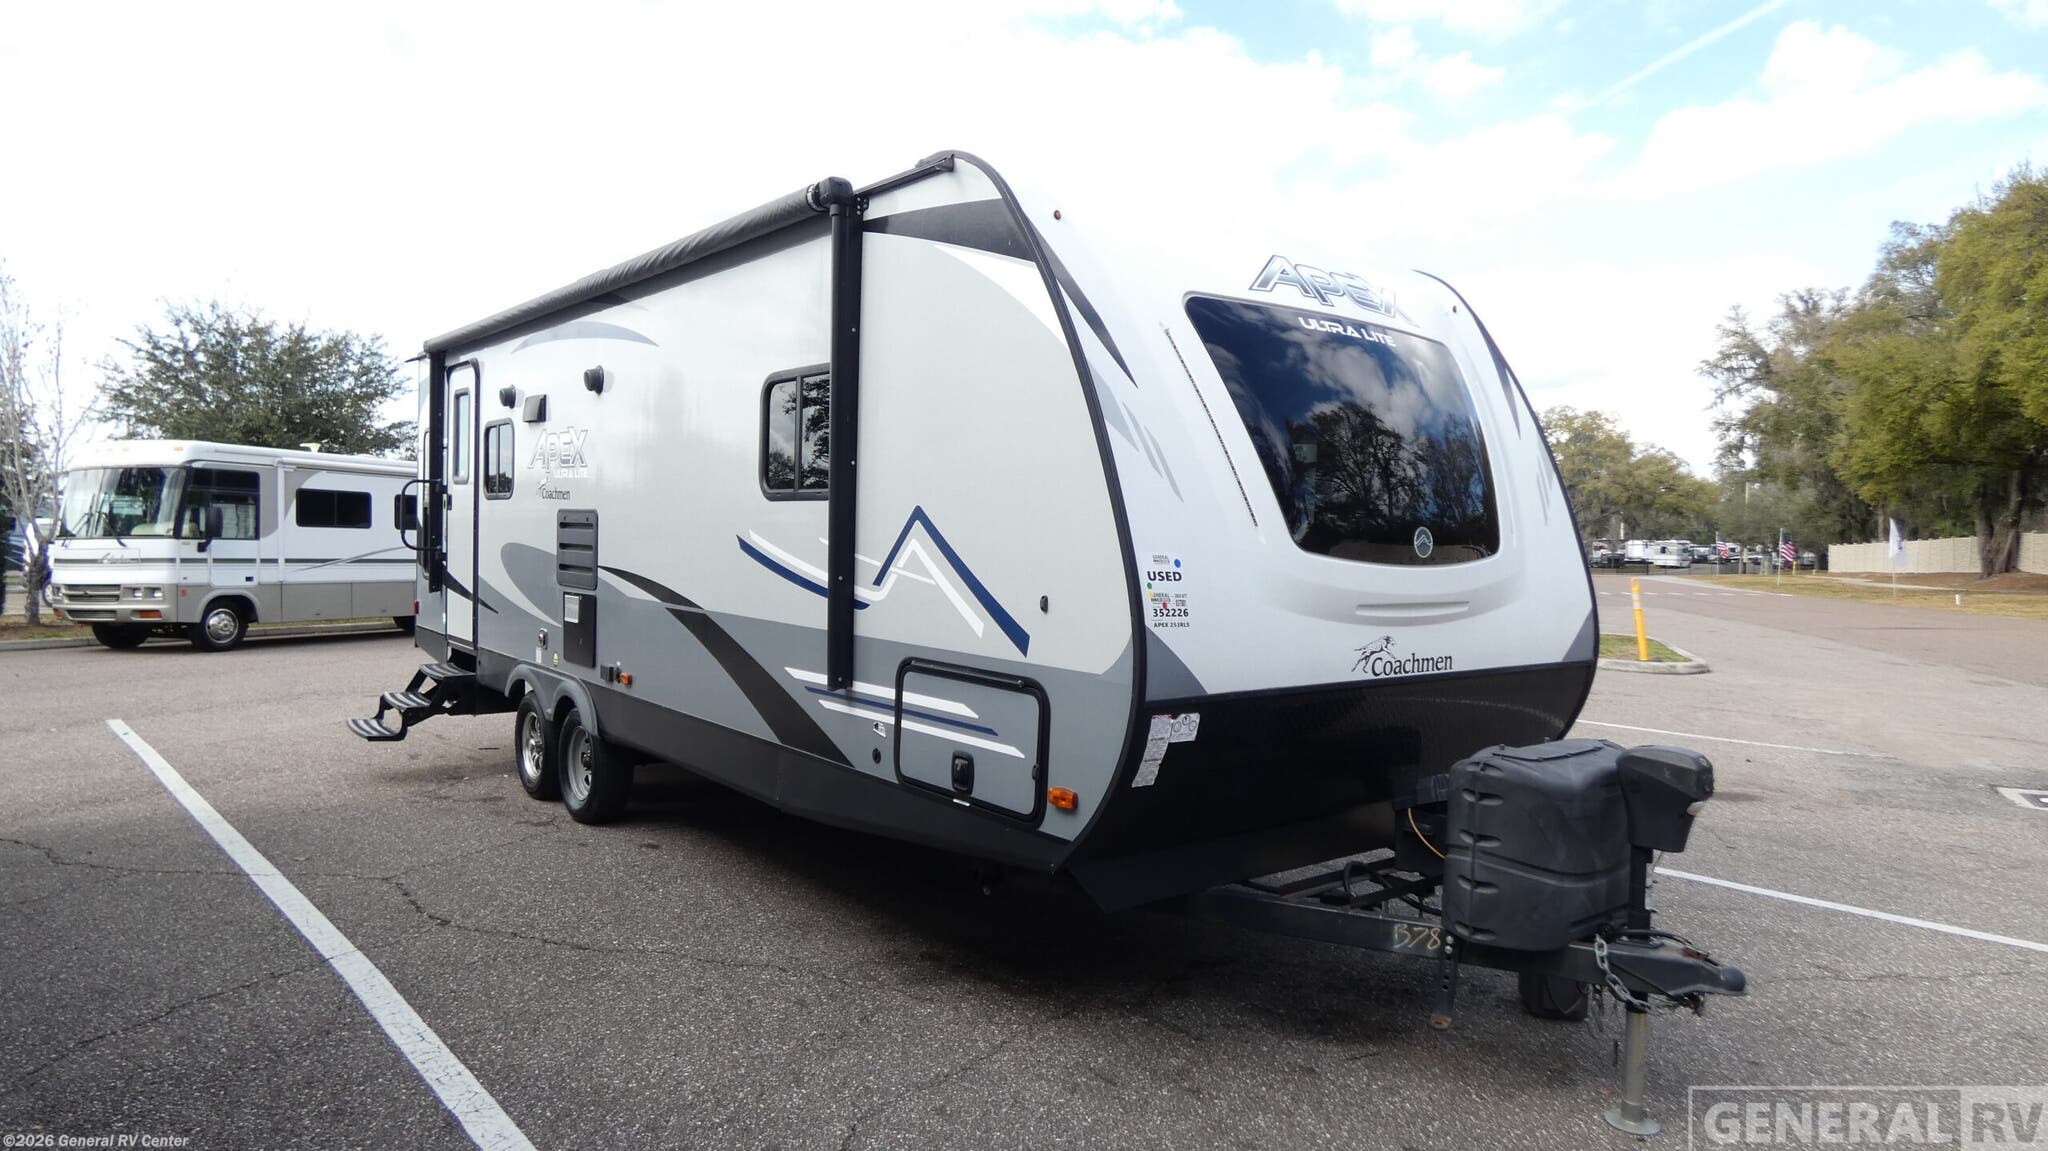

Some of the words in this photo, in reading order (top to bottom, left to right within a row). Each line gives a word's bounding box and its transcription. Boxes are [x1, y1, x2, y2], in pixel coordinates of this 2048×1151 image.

[1248, 254, 1420, 329] APEX
[1298, 317, 1361, 339] ULTRA
[1361, 328, 1396, 347] LITE
[527, 425, 589, 474] APEX
[541, 487, 571, 500] Coachmen
[1147, 571, 1182, 581] USED
[1153, 608, 1189, 617] 352226
[1371, 652, 1453, 677] Coachmen
[1393, 923, 1441, 950] B78
